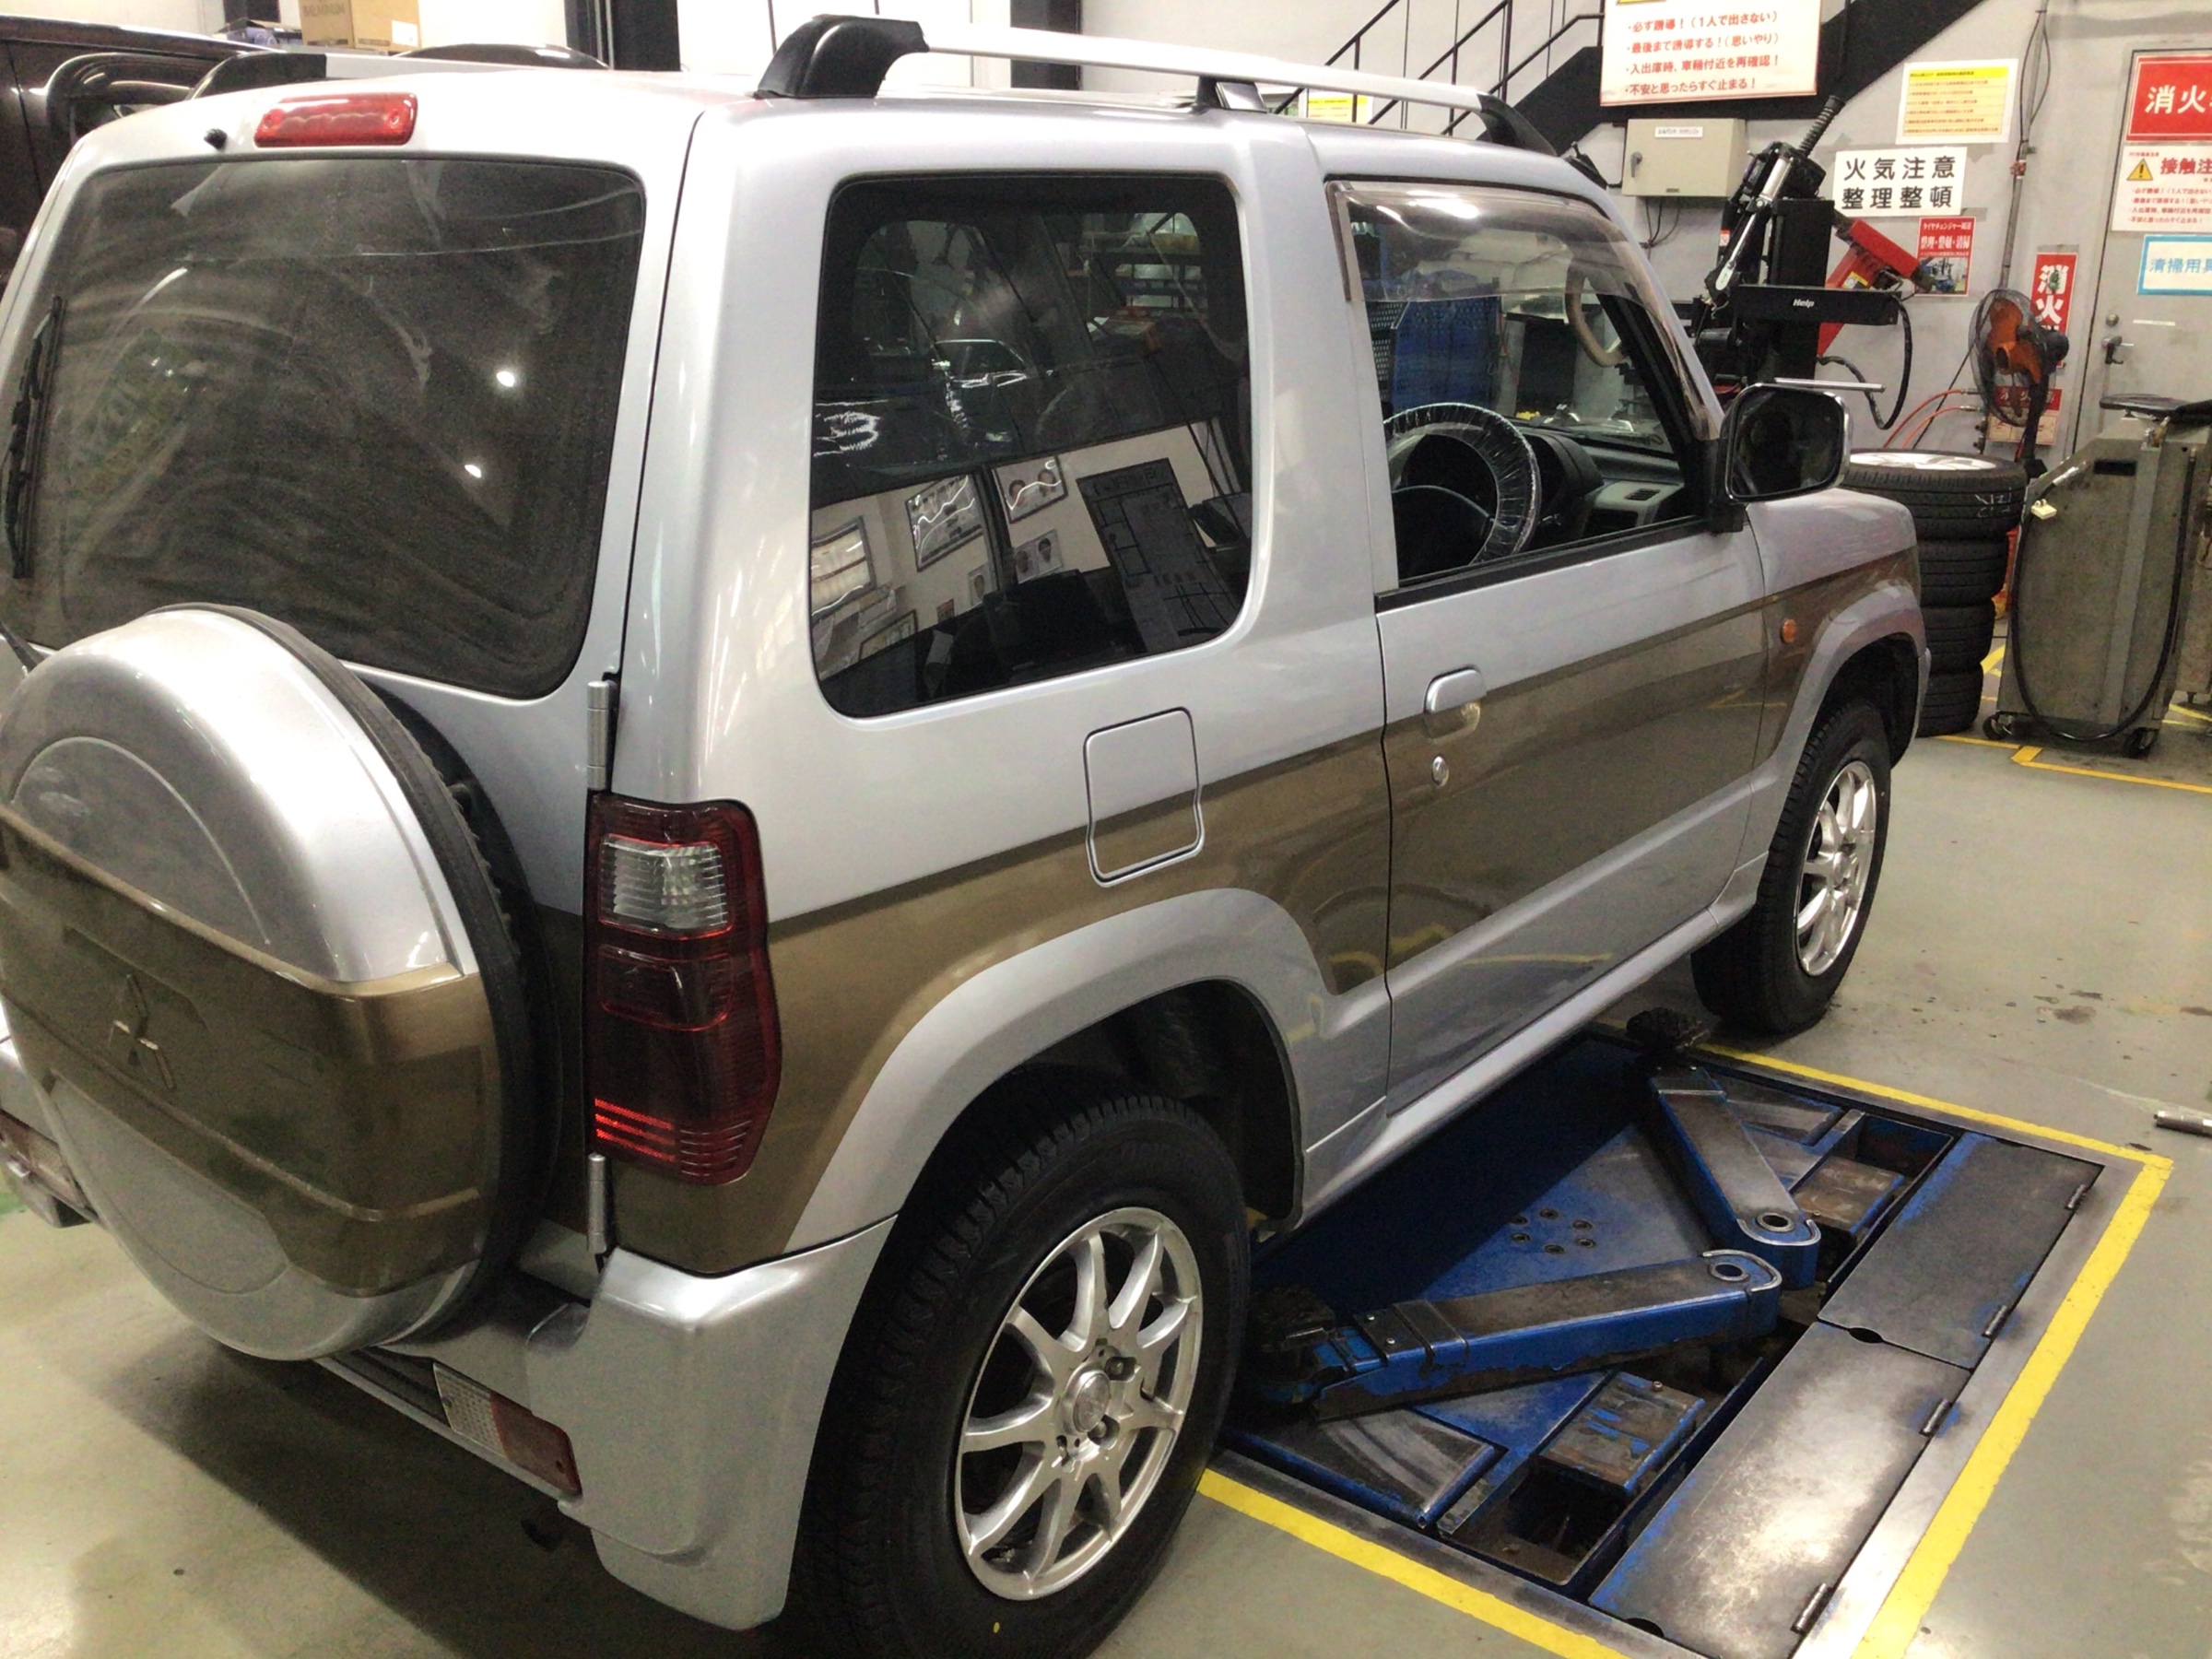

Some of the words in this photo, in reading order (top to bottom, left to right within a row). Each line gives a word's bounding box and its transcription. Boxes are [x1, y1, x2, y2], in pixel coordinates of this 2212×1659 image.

[2145, 84, 2212, 114] 消火
[1843, 155, 1956, 181] 火気注意
[1841, 185, 1954, 210] 整理整頓
[1793, 298, 1815, 309] Help
